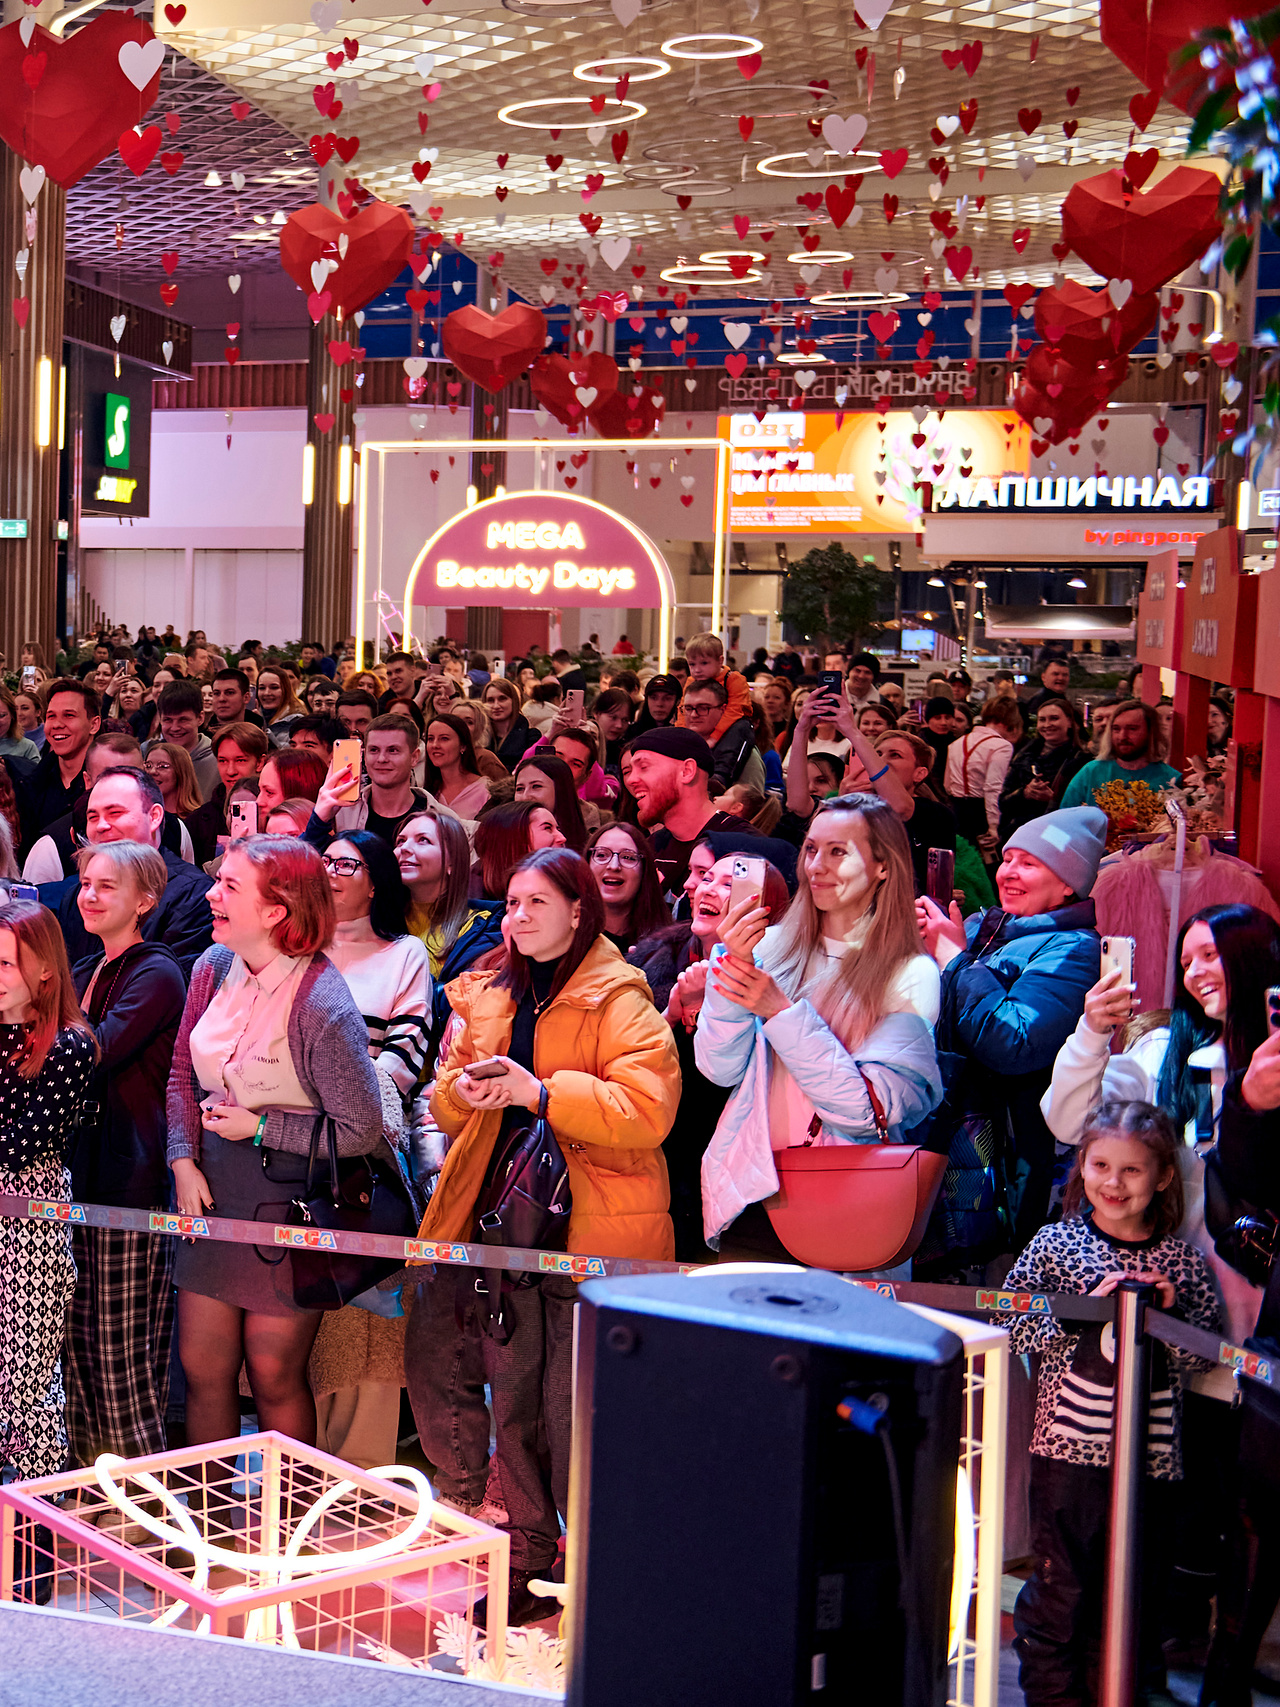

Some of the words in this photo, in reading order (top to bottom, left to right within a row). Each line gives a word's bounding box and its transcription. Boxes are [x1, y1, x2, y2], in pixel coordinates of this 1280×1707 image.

[739, 423, 795, 437] OBI
[940, 475, 1210, 508] ЛАПШИЧНАЯ
[486, 521, 586, 550] MEGA
[1084, 529, 1111, 546] by
[436, 559, 551, 595] Beauty
[553, 560, 637, 596] Days
